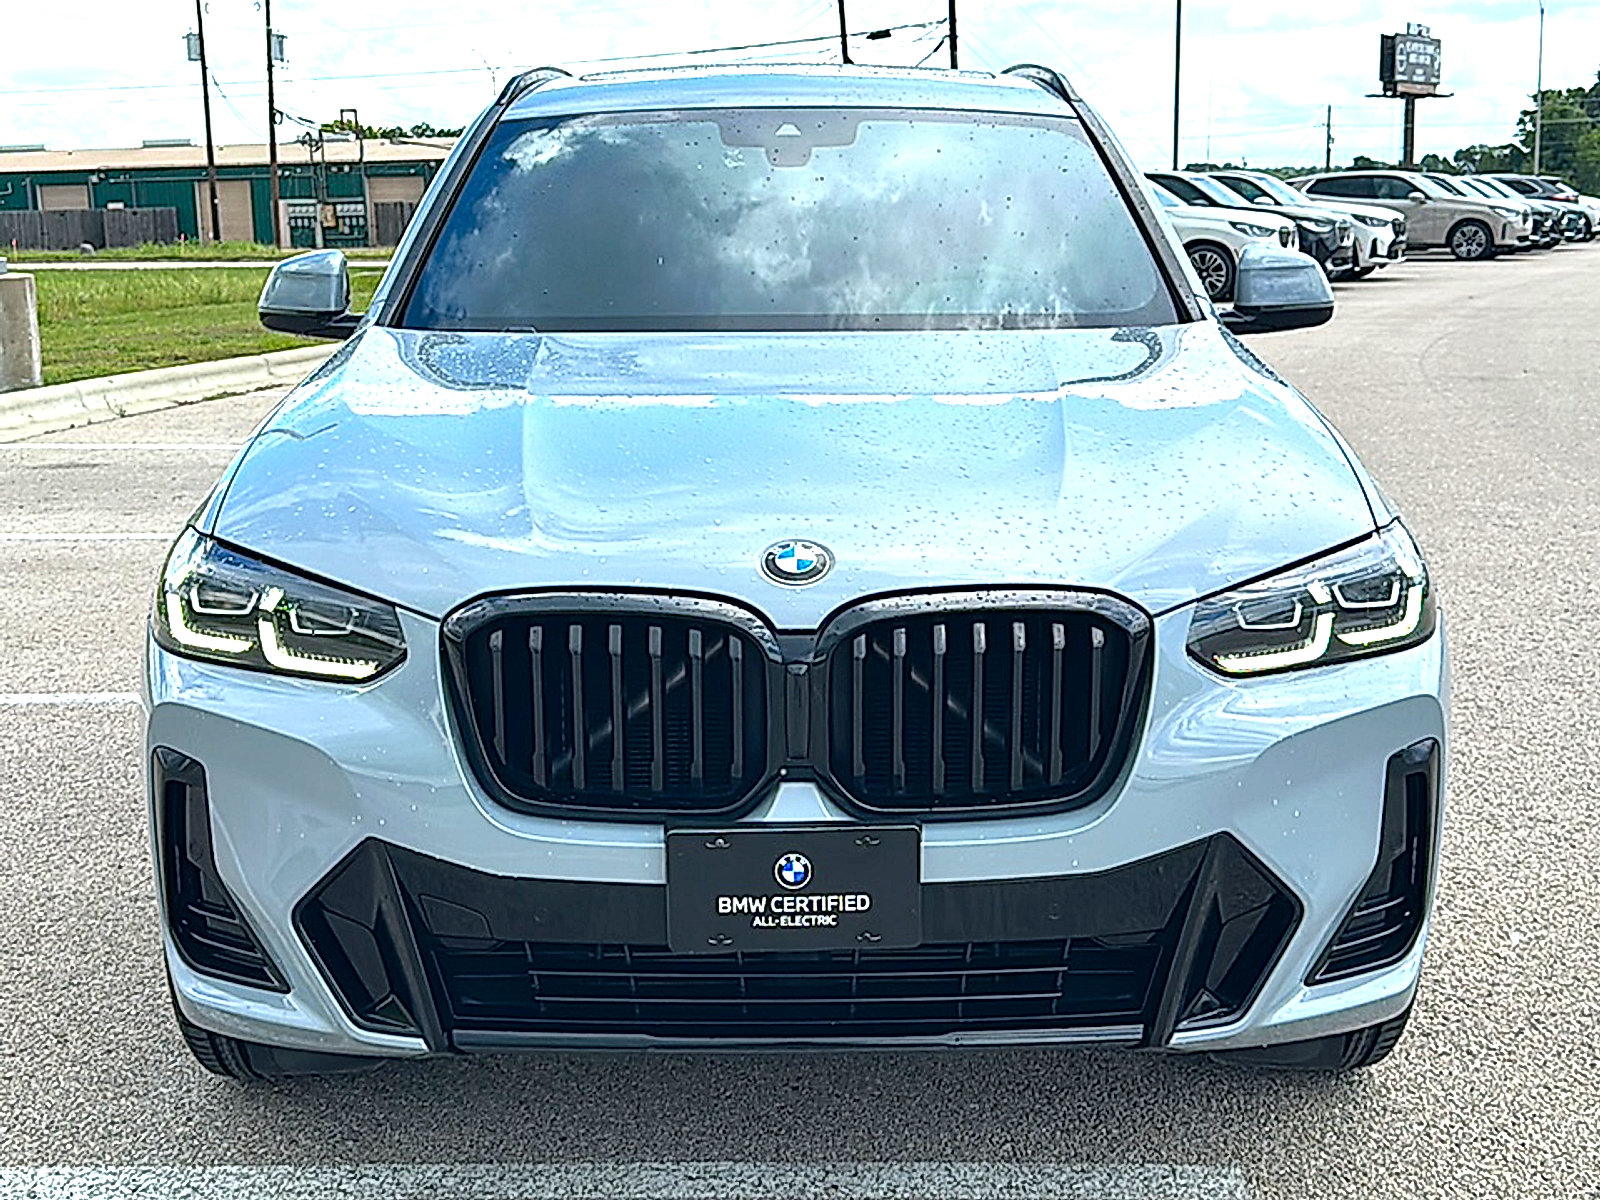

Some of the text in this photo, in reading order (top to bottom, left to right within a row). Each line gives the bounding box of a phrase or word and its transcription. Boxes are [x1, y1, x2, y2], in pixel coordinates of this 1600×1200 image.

[718, 895, 870, 914] BMW CERTIFIED
[752, 915, 838, 927] ALL-ELECTRIC
